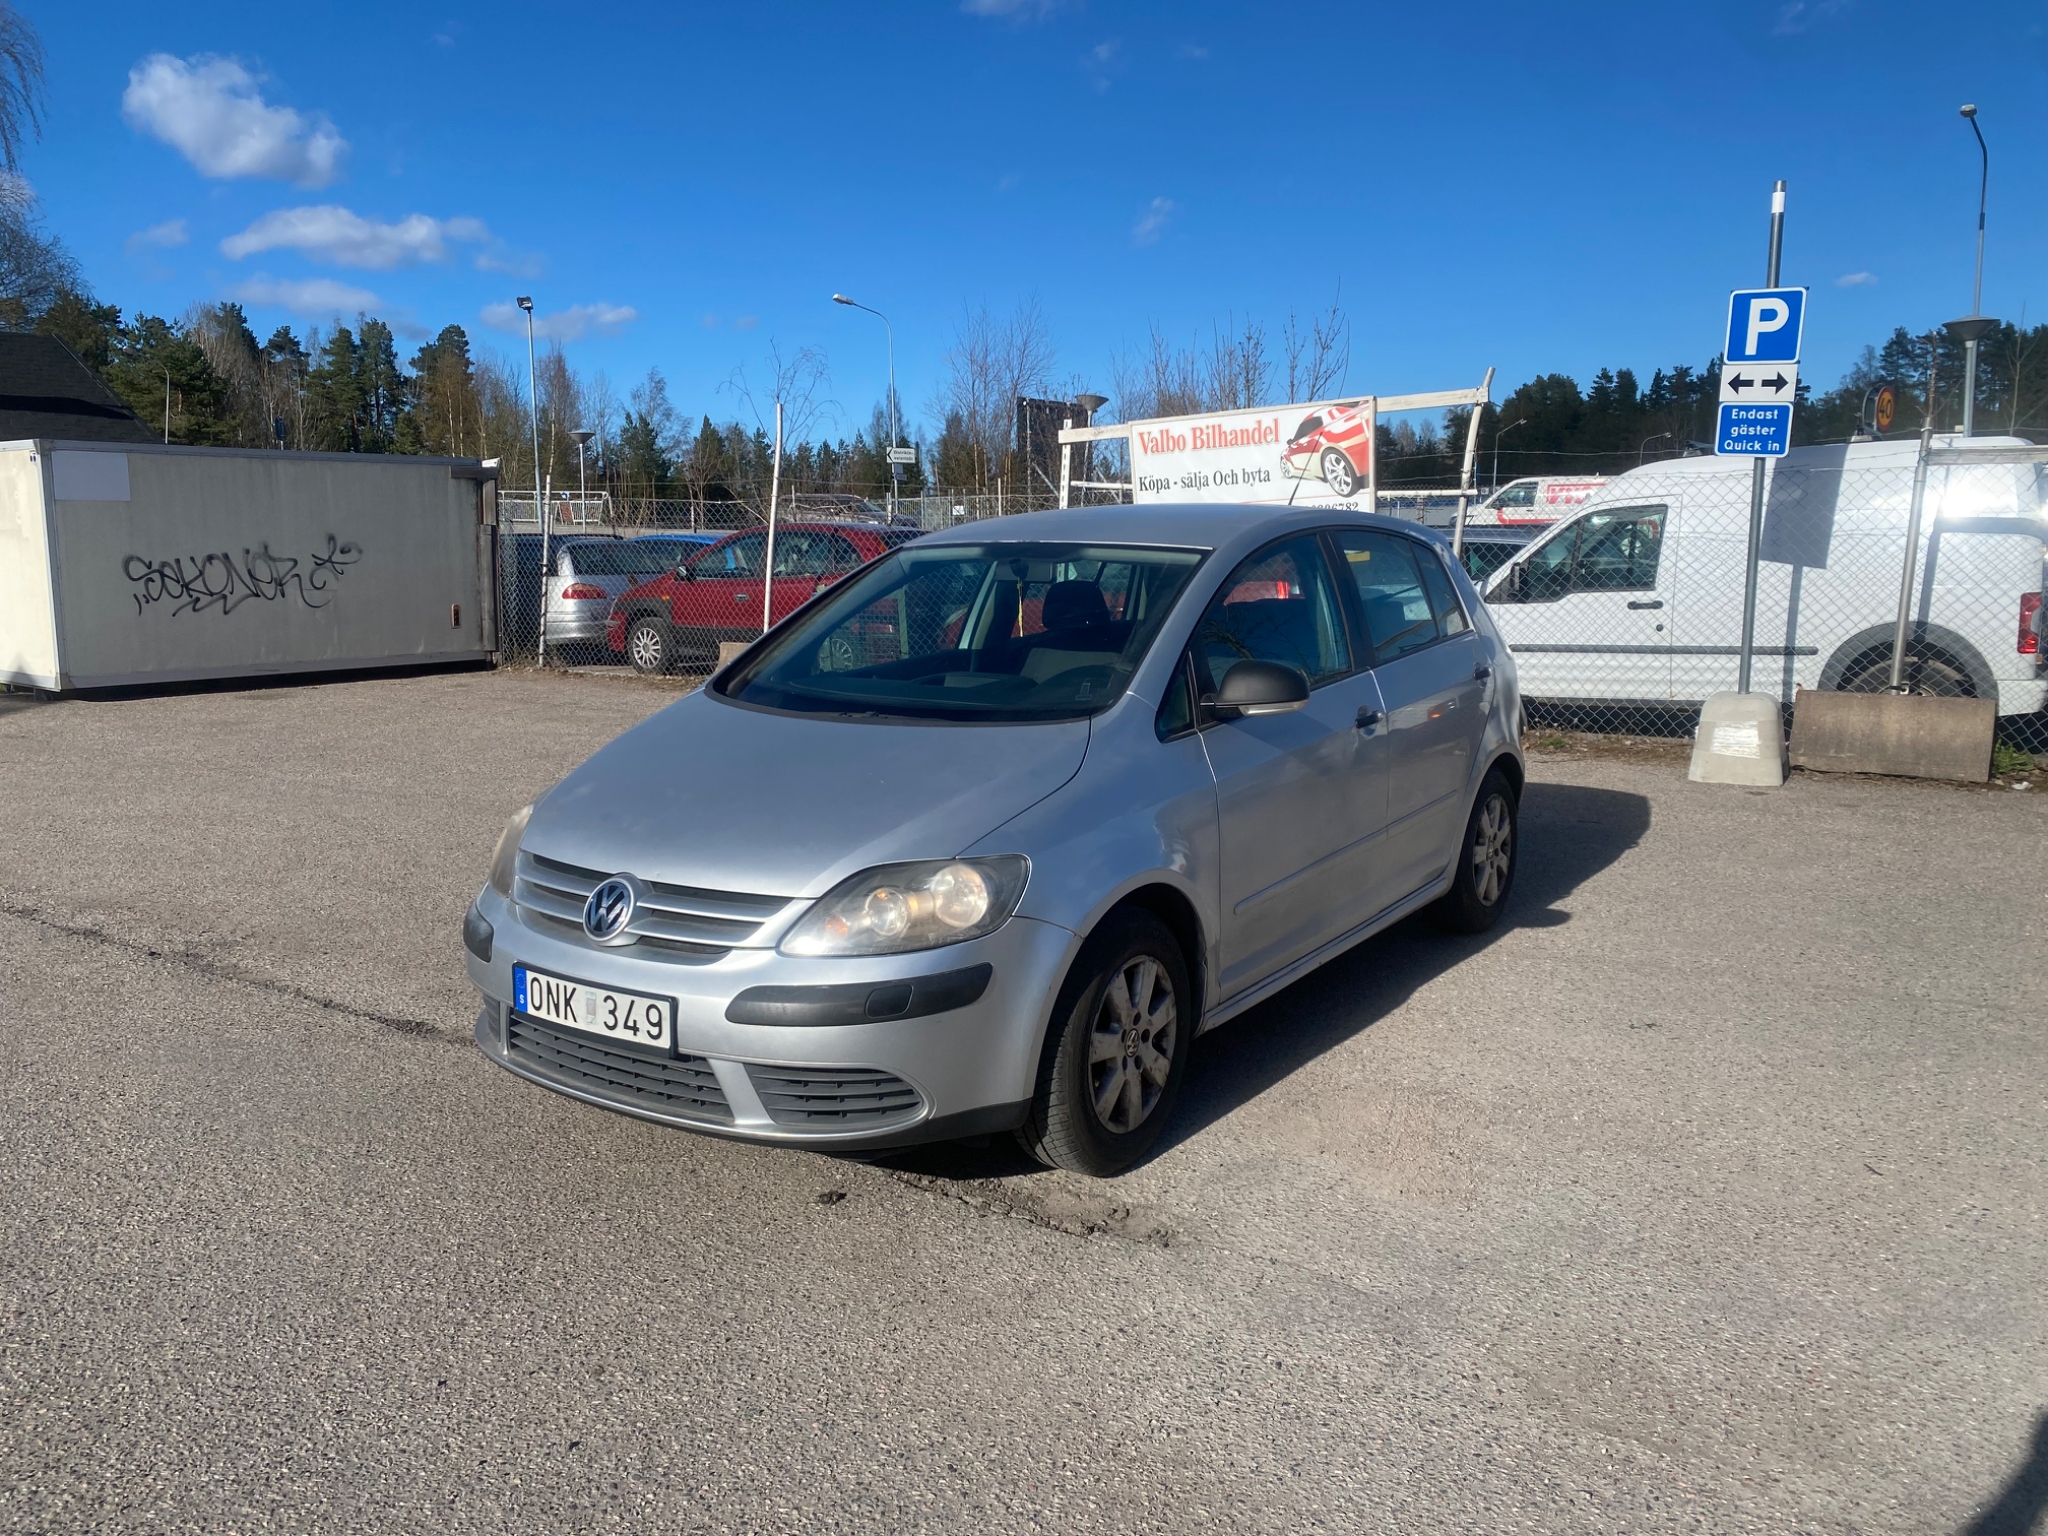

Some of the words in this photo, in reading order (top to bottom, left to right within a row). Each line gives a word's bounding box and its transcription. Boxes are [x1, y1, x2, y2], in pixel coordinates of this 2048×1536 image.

[1745, 297, 1789, 356] P
[1731, 408, 1779, 420] Endast
[1878, 397, 1892, 420] 40
[1138, 428, 1187, 455] Valbo
[1191, 418, 1280, 450] Bilhandel
[1730, 423, 1776, 438] gäster
[1724, 439, 1763, 451] Quick
[1768, 440, 1780, 452] in
[1139, 475, 1171, 494] Köpa
[1180, 471, 1210, 491] sälja
[1213, 469, 1239, 487] Och
[1241, 467, 1271, 487] byta
[519, 993, 525, 1004] S
[530, 976, 578, 1023] ONK
[603, 995, 662, 1041] 349
